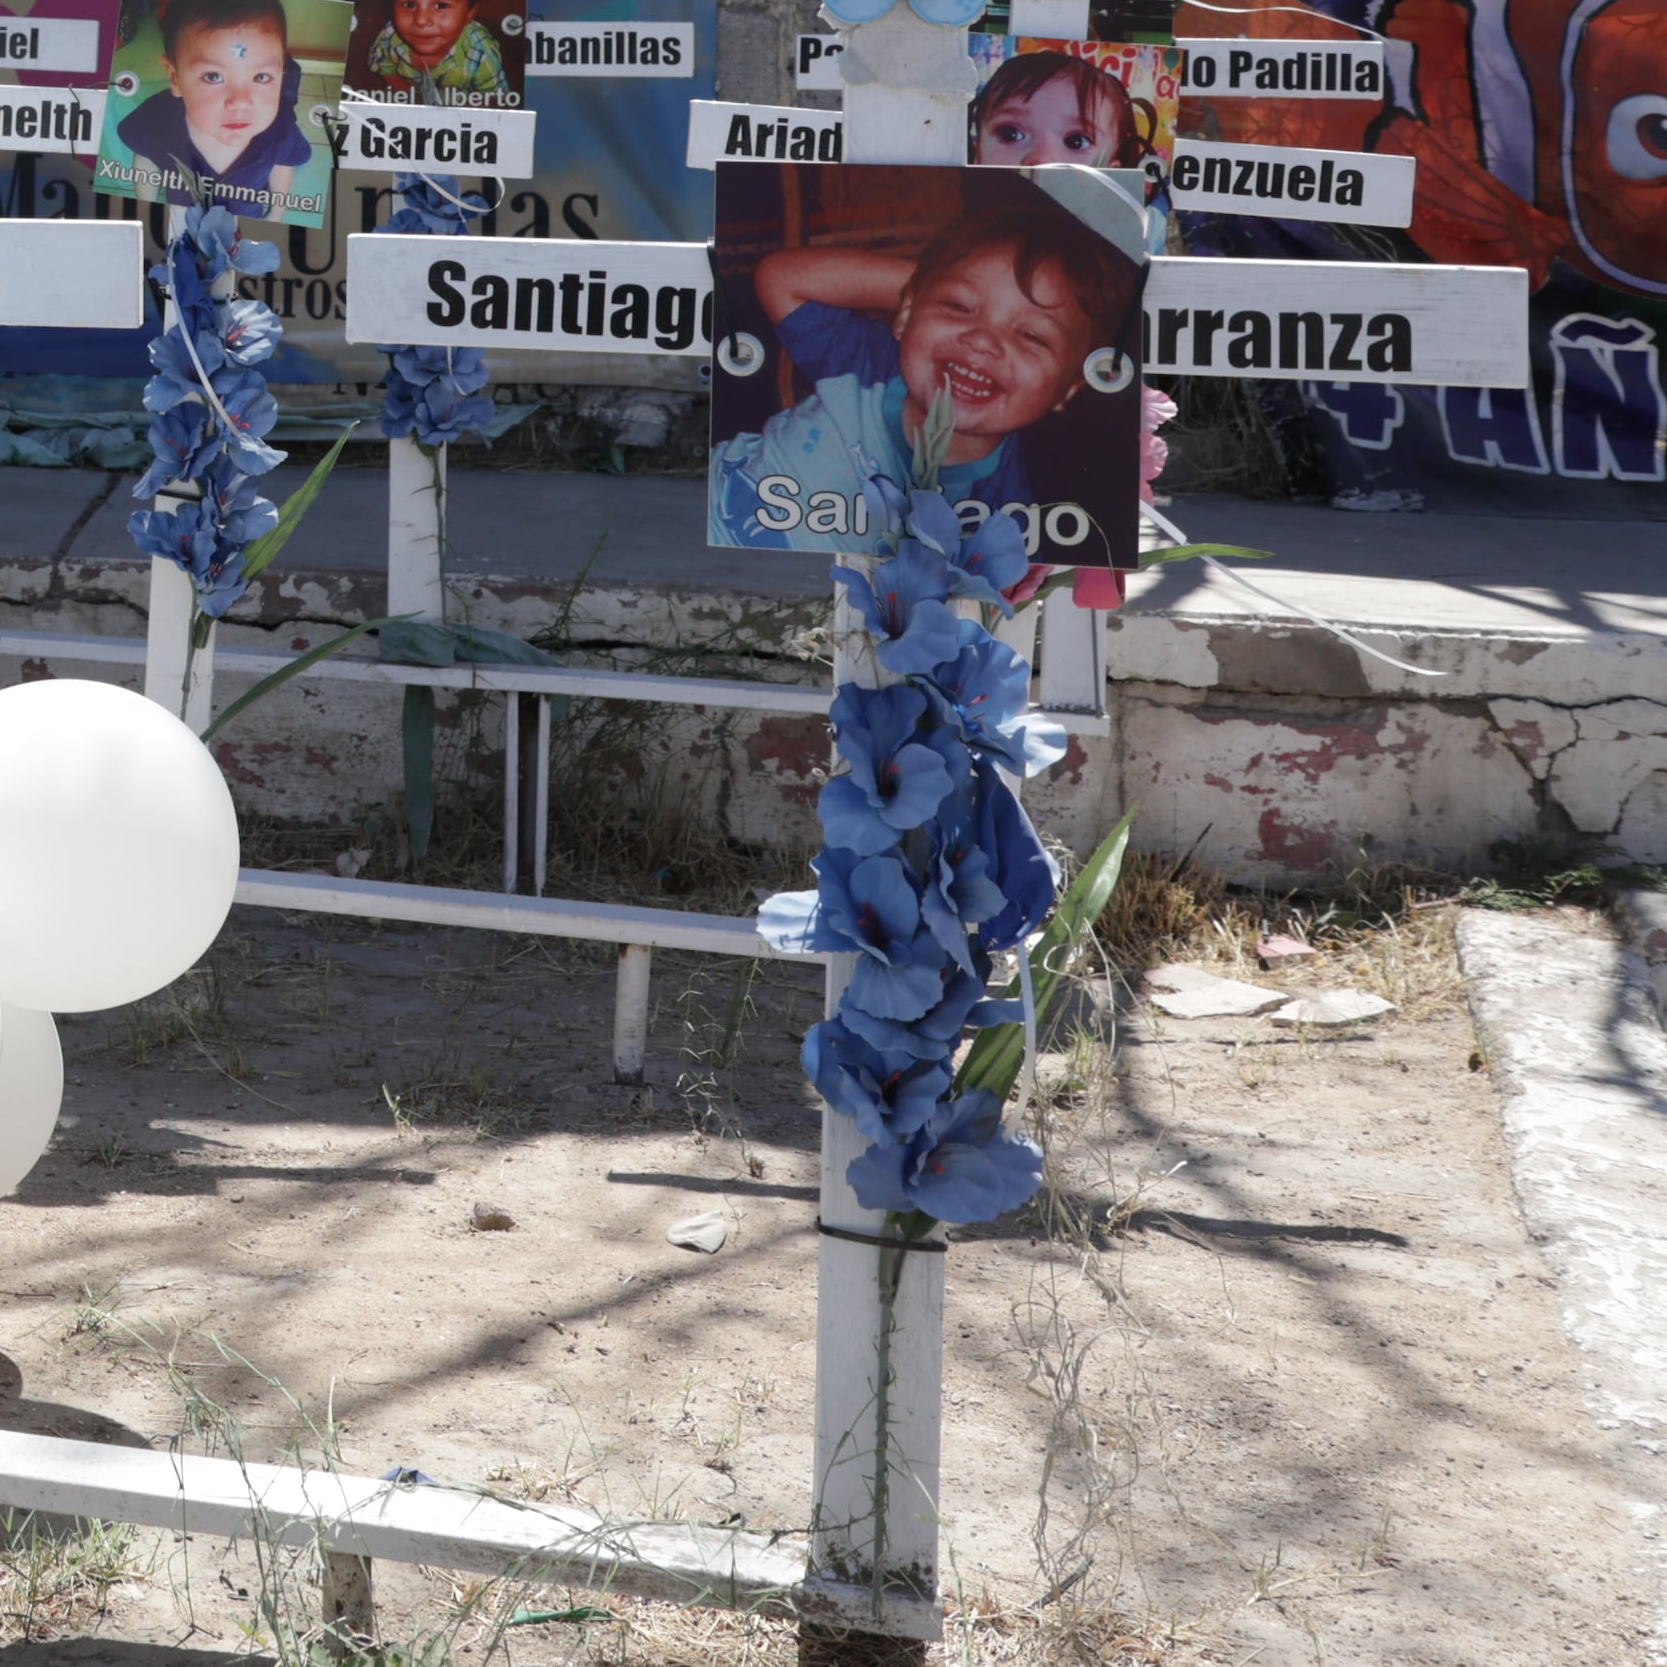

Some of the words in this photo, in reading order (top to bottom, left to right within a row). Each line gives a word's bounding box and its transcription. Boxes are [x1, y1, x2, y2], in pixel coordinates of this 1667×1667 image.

[525, 31, 681, 65] banillas
[1229, 50, 1380, 92] Padilla
[360, 117, 498, 164] Garcia
[725, 114, 843, 161] Ariad
[1172, 153, 1364, 206] enzuela
[199, 174, 322, 213] Emmanuel
